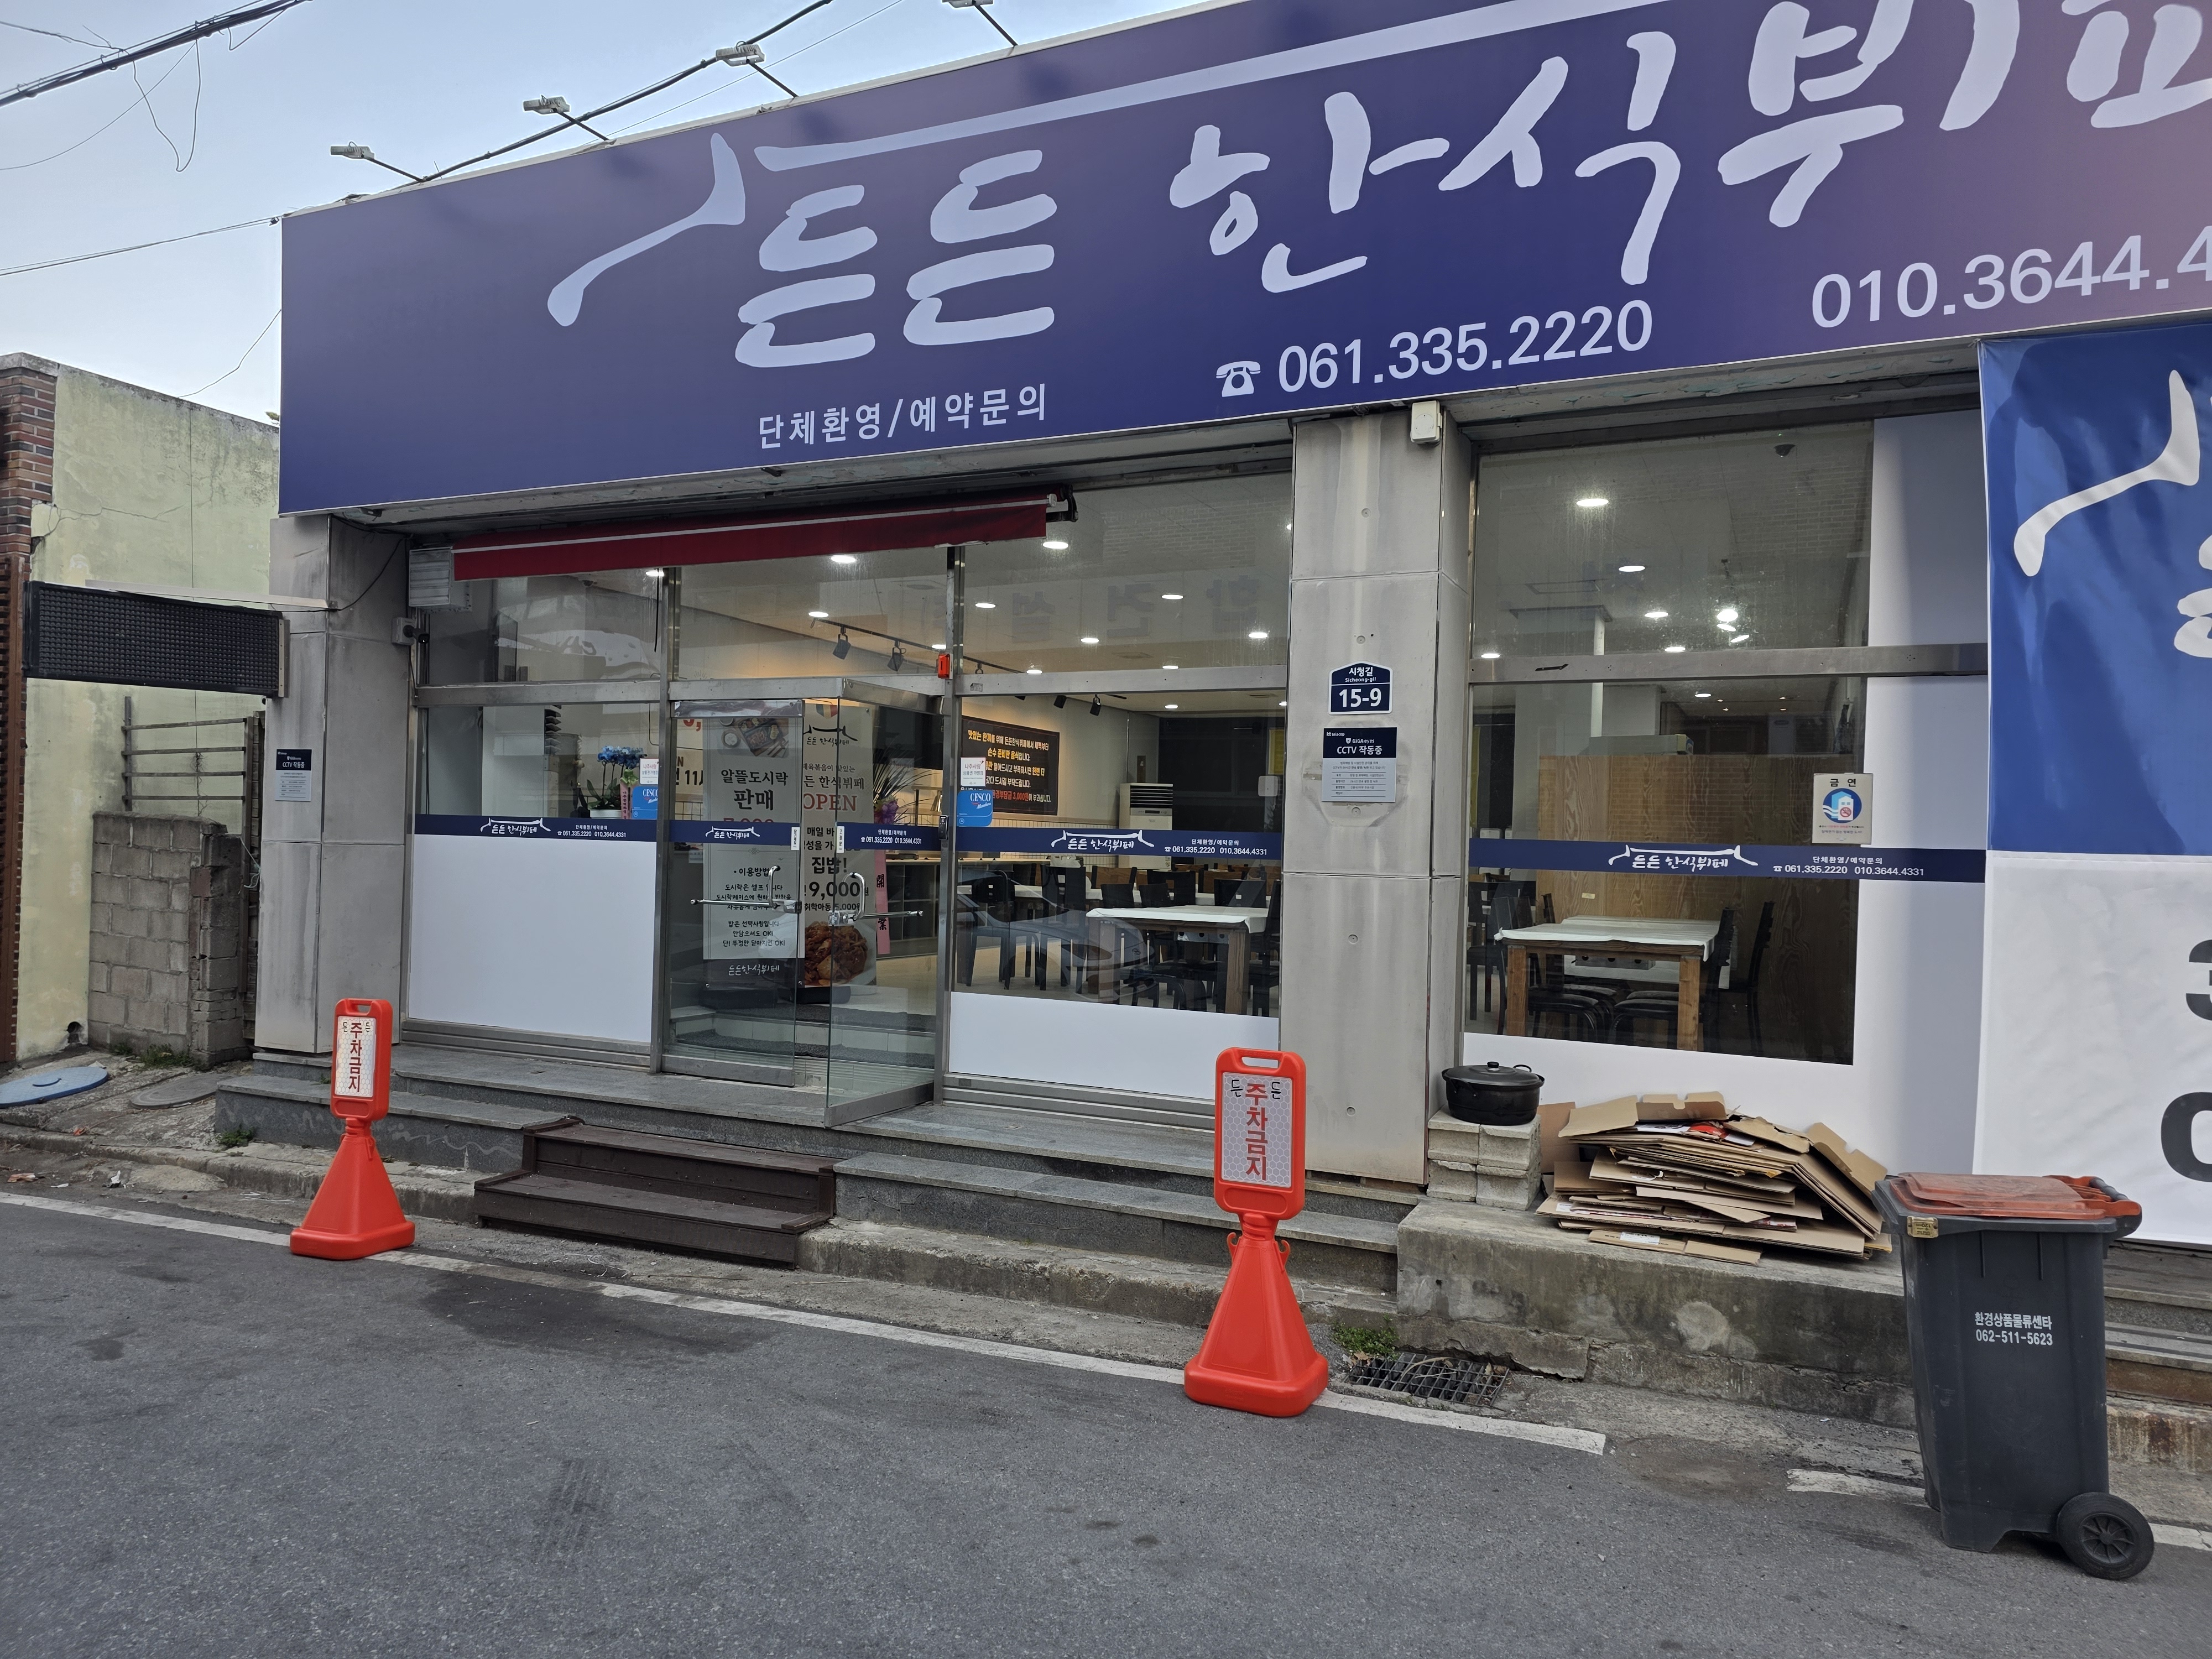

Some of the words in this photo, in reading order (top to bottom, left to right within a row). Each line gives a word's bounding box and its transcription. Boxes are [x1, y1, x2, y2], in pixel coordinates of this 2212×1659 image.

[736, 150, 1057, 367] 든든
[1278, 299, 1652, 393] 061.335.2220
[759, 383, 1045, 449] 단체환영/예약문의
[1349, 666, 1373, 676] 시청길
[1339, 687, 1381, 707] 15-9
[807, 736, 817, 745] 든든
[996, 735, 1004, 744] 위해
[988, 747, 997, 757] 손수
[998, 748, 1010, 759] 준비한
[1010, 750, 1031, 761] 음식입니다.
[1337, 746, 1357, 754] CCTV
[1359, 745, 1383, 755] 작동중
[721, 769, 789, 786] 알뜰도시락
[818, 776, 864, 790] 한식뷔페
[734, 788, 774, 811] 판매
[804, 793, 857, 811] OPEN
[970, 792, 991, 802] CESCO
[492, 824, 505, 834] 든든
[807, 827, 824, 837] 매일
[804, 840, 823, 851] 성을
[1067, 838, 1087, 849] 든든
[1091, 838, 1135, 852] 한식뷔페
[1172, 846, 1215, 854] 061.335.2220
[1219, 847, 1267, 855] 010.3644.4331
[811, 857, 847, 874] 집밥!
[1631, 855, 1660, 868] 든든
[1665, 855, 1729, 873] 한식뷔페
[1785, 865, 1848, 874] 061.335.2220
[1854, 866, 1924, 876] 010.3644.4331
[739, 867, 770, 877] 이용방법
[804, 902, 832, 911] 취학아동
[348, 1022, 363, 1093] 주차금지
[1230, 1079, 1243, 1097] 든
[1271, 1081, 1281, 1100] 든
[1245, 1083, 1268, 1181] 주차금지
[1975, 1312, 2052, 1331] 환경상품물류센타
[1976, 1329, 2053, 1346] 062-511-5623
